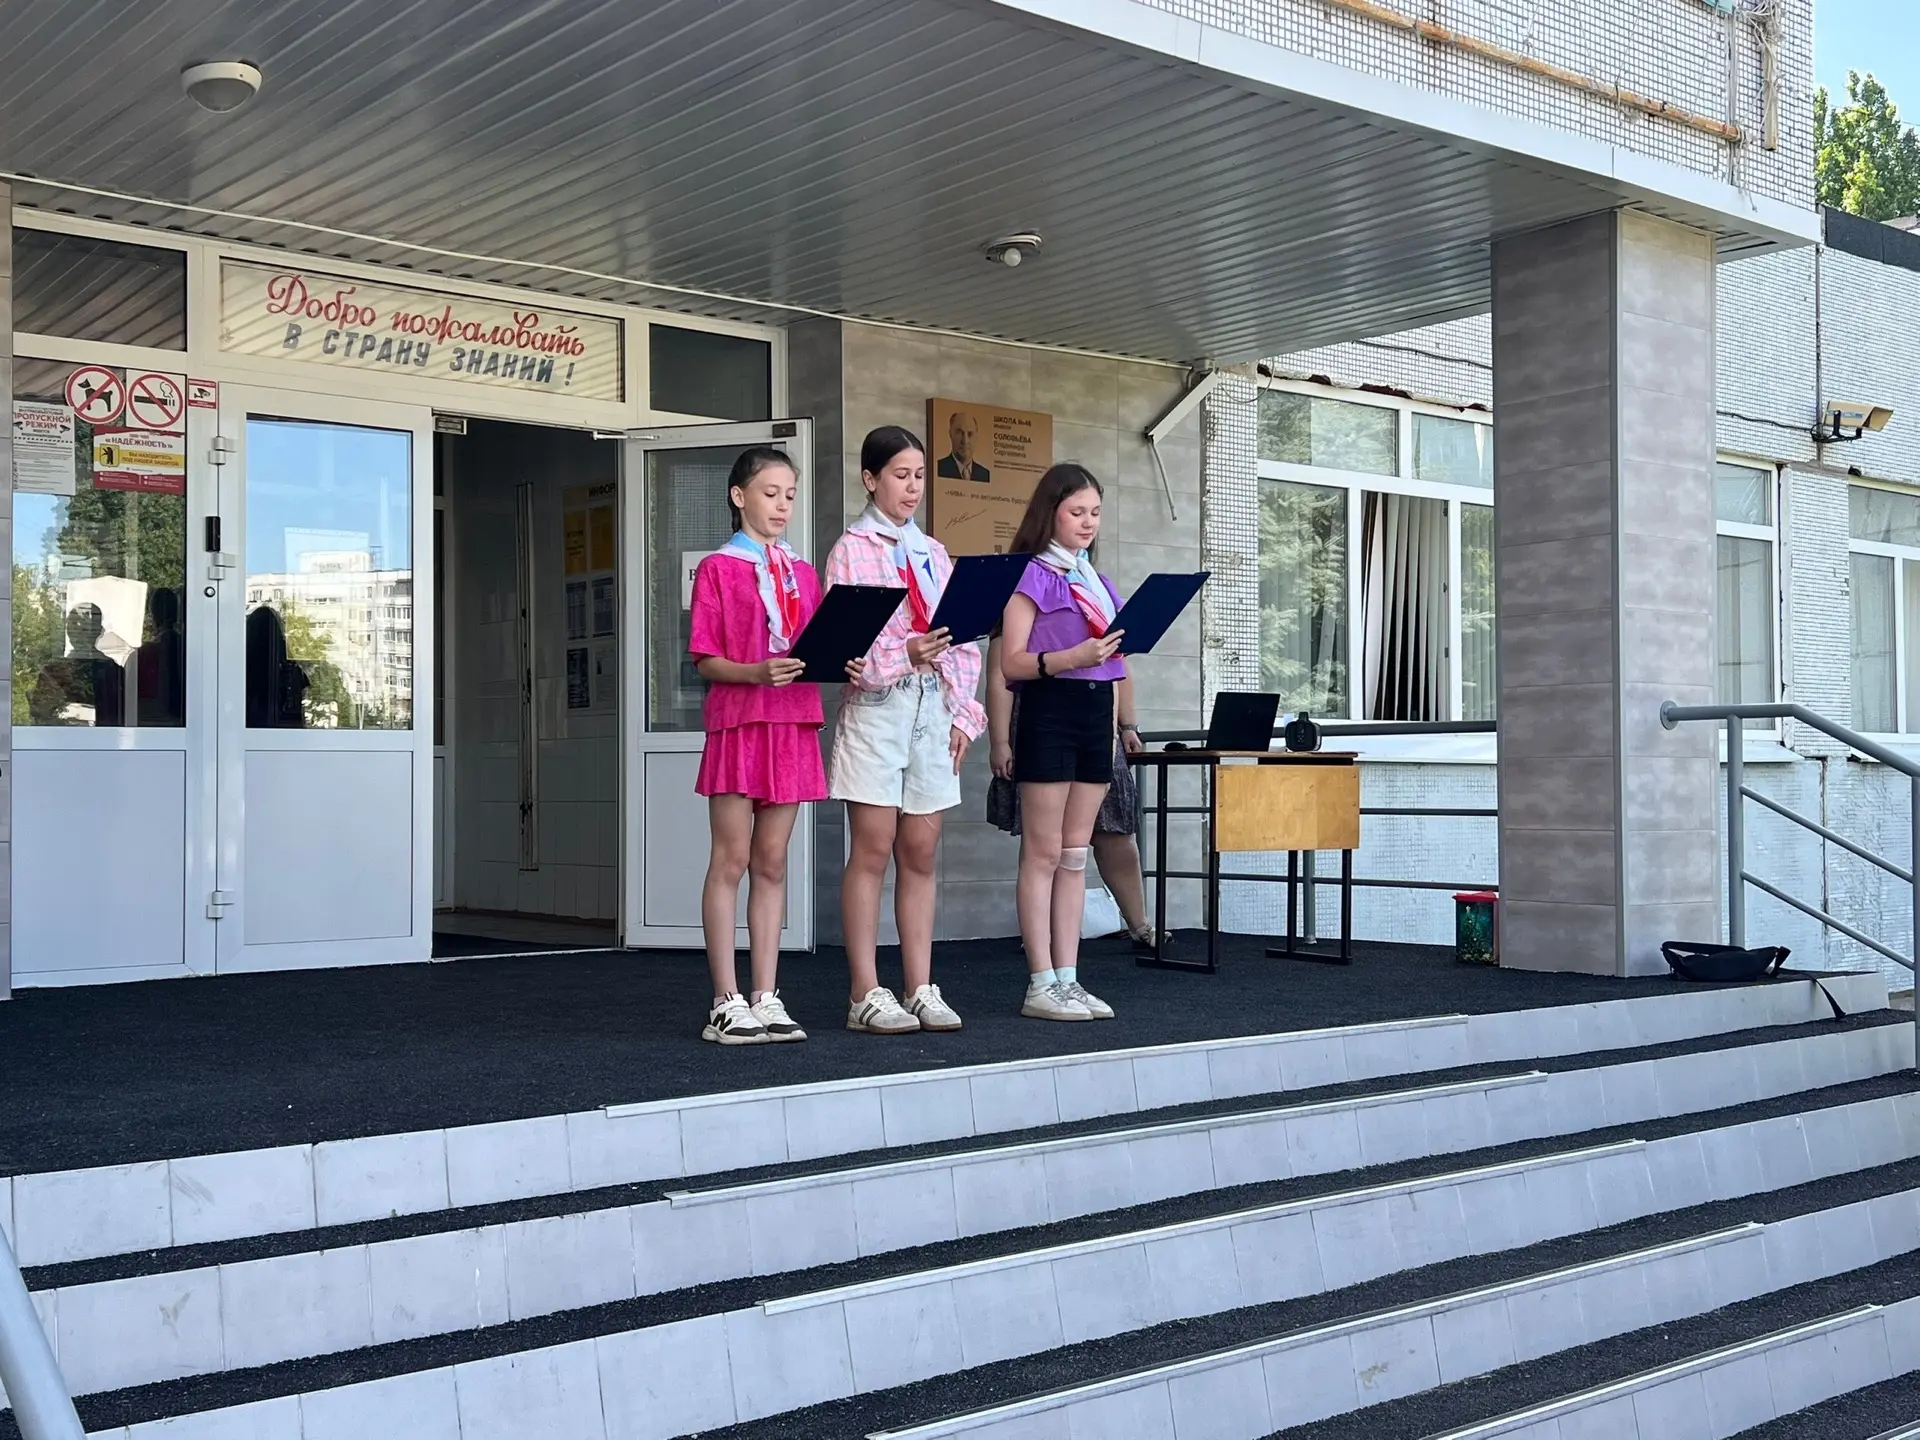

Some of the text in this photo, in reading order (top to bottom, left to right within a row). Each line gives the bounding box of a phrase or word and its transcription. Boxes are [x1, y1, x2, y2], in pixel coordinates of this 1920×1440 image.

[266, 274, 585, 357] Добро пожаловать
[282, 322, 576, 386] В СТРАНУ ЗНАНИЙ !
[13, 412, 71, 423] ПРОПУСКНОЙ
[993, 415, 1017, 425] ШКОЛА
[25, 420, 58, 430] РЕЖИМ
